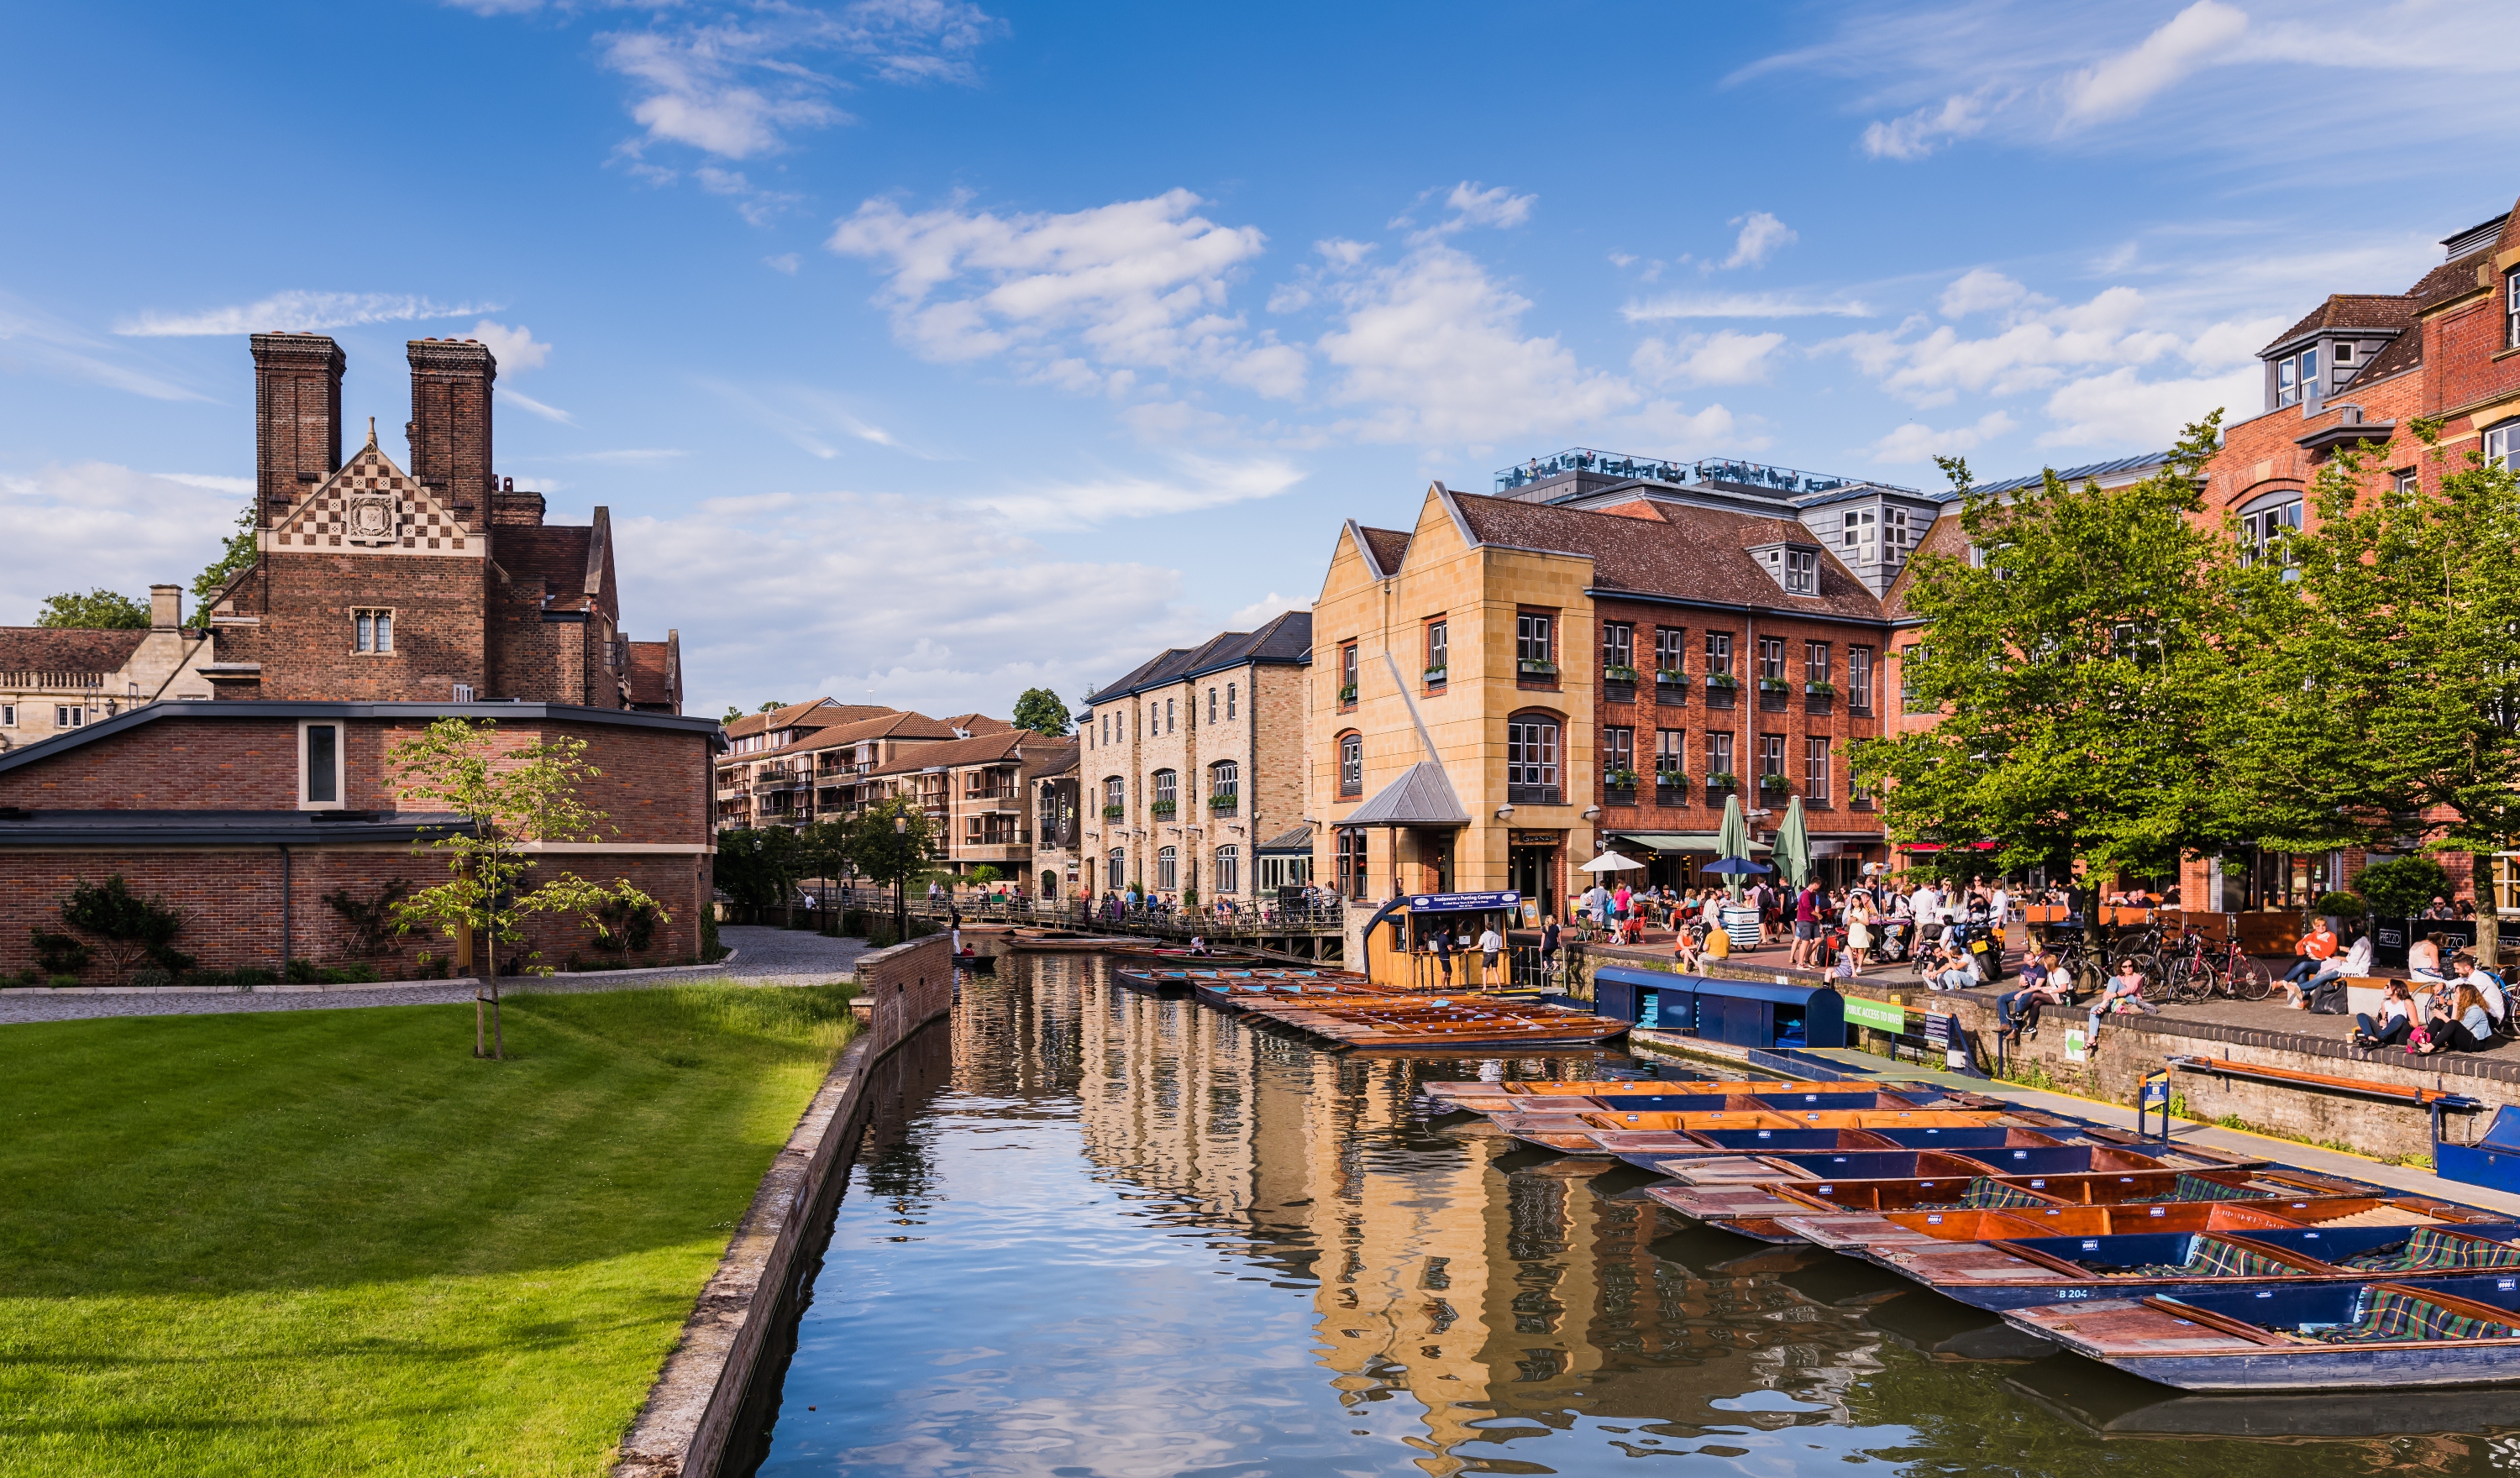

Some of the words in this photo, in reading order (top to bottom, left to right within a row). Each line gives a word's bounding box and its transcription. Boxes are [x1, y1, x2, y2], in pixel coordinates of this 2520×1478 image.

[2380, 931, 2400, 944] PREZZO
[1845, 1004, 1861, 1015] PUBLIC
[1861, 1008, 1880, 1020] ACCESS
[1880, 1010, 1887, 1021] TO
[1887, 1013, 1902, 1025] RIVER
[2059, 1290, 2066, 1298] B
[2068, 1289, 2087, 1298] 204
